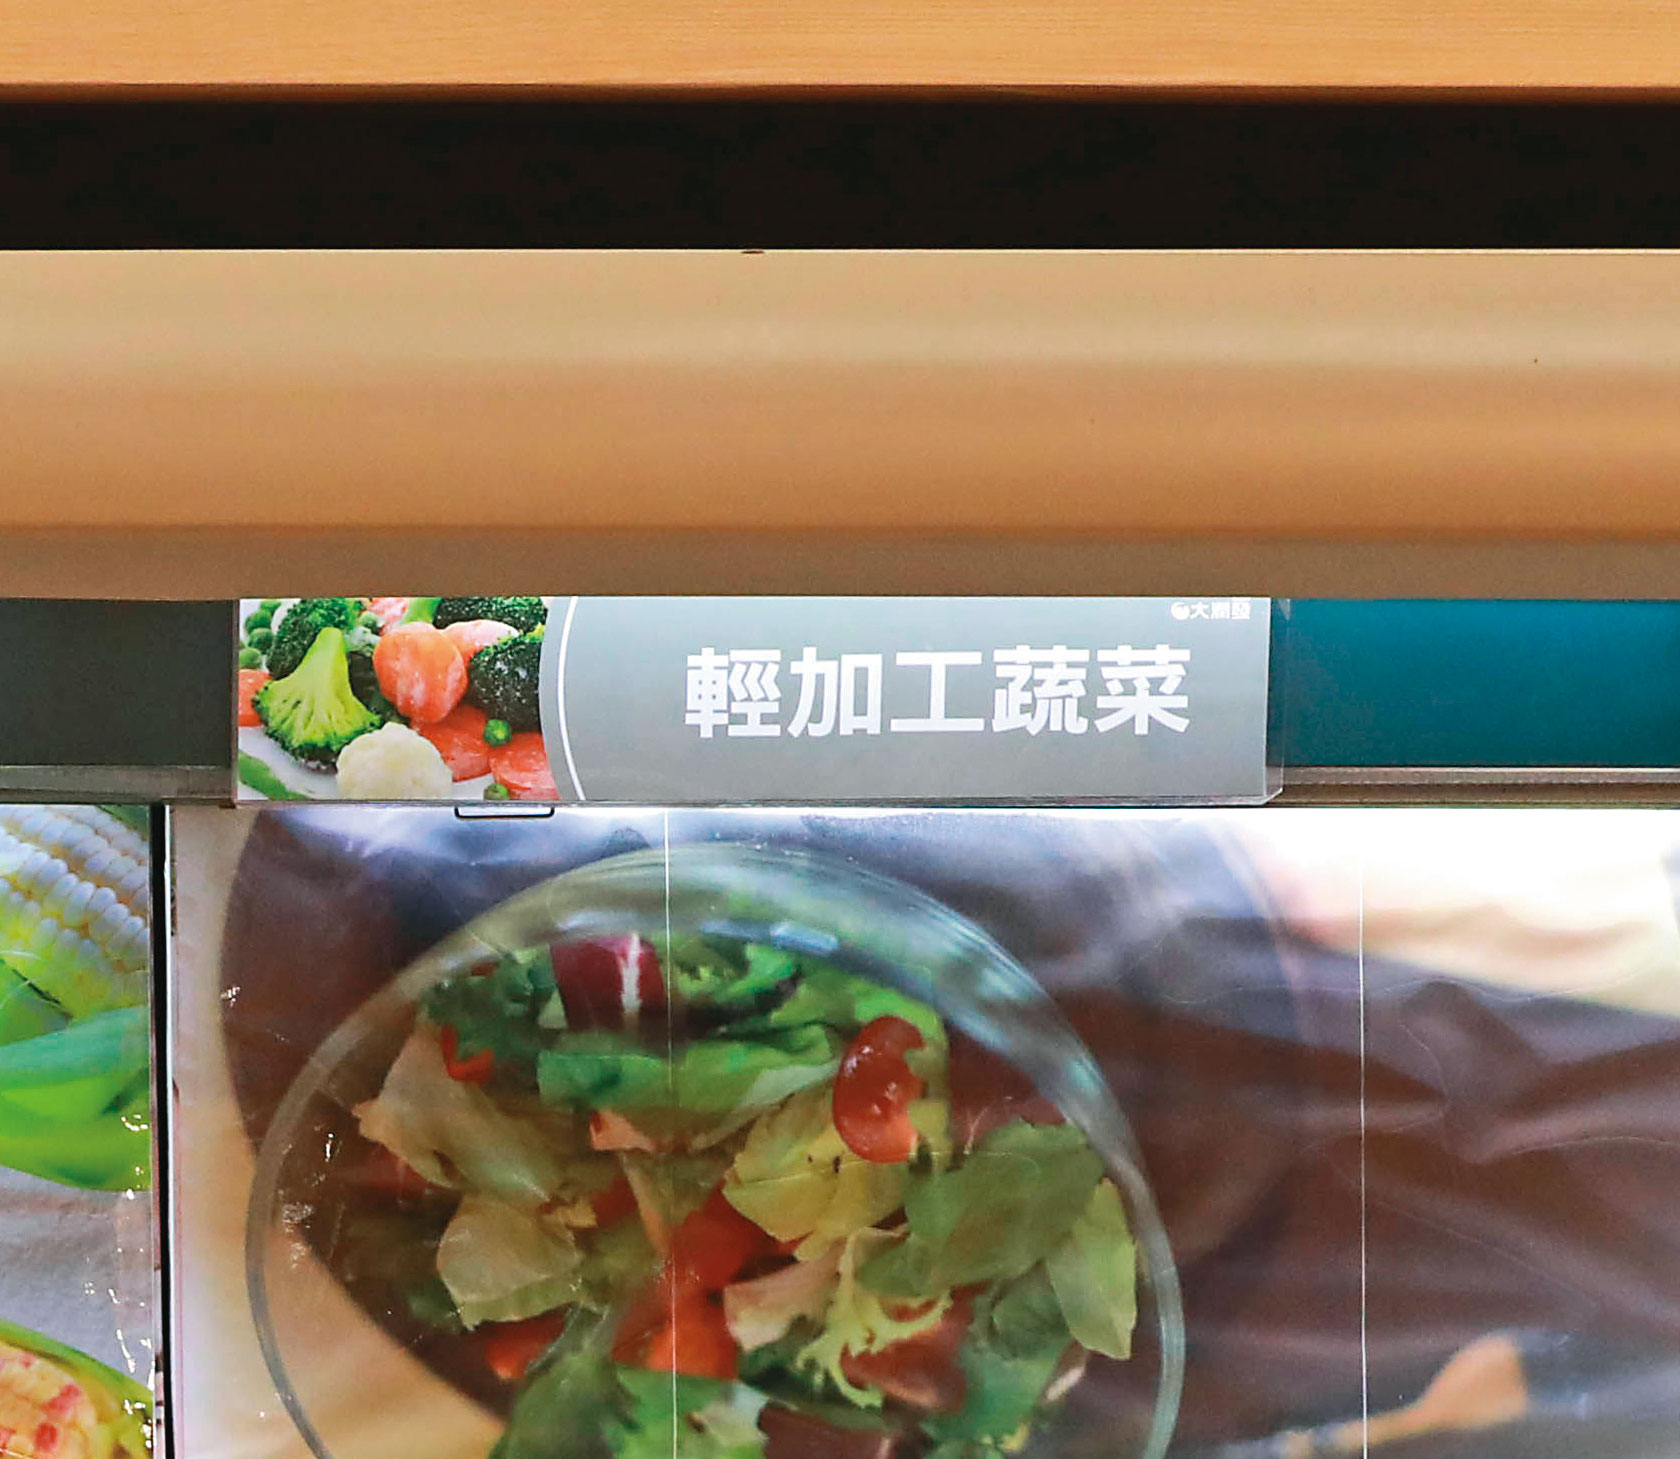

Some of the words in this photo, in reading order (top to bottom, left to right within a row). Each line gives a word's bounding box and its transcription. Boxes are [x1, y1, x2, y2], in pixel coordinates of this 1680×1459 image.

[684, 643, 1191, 739] 輕加工蔬菜
